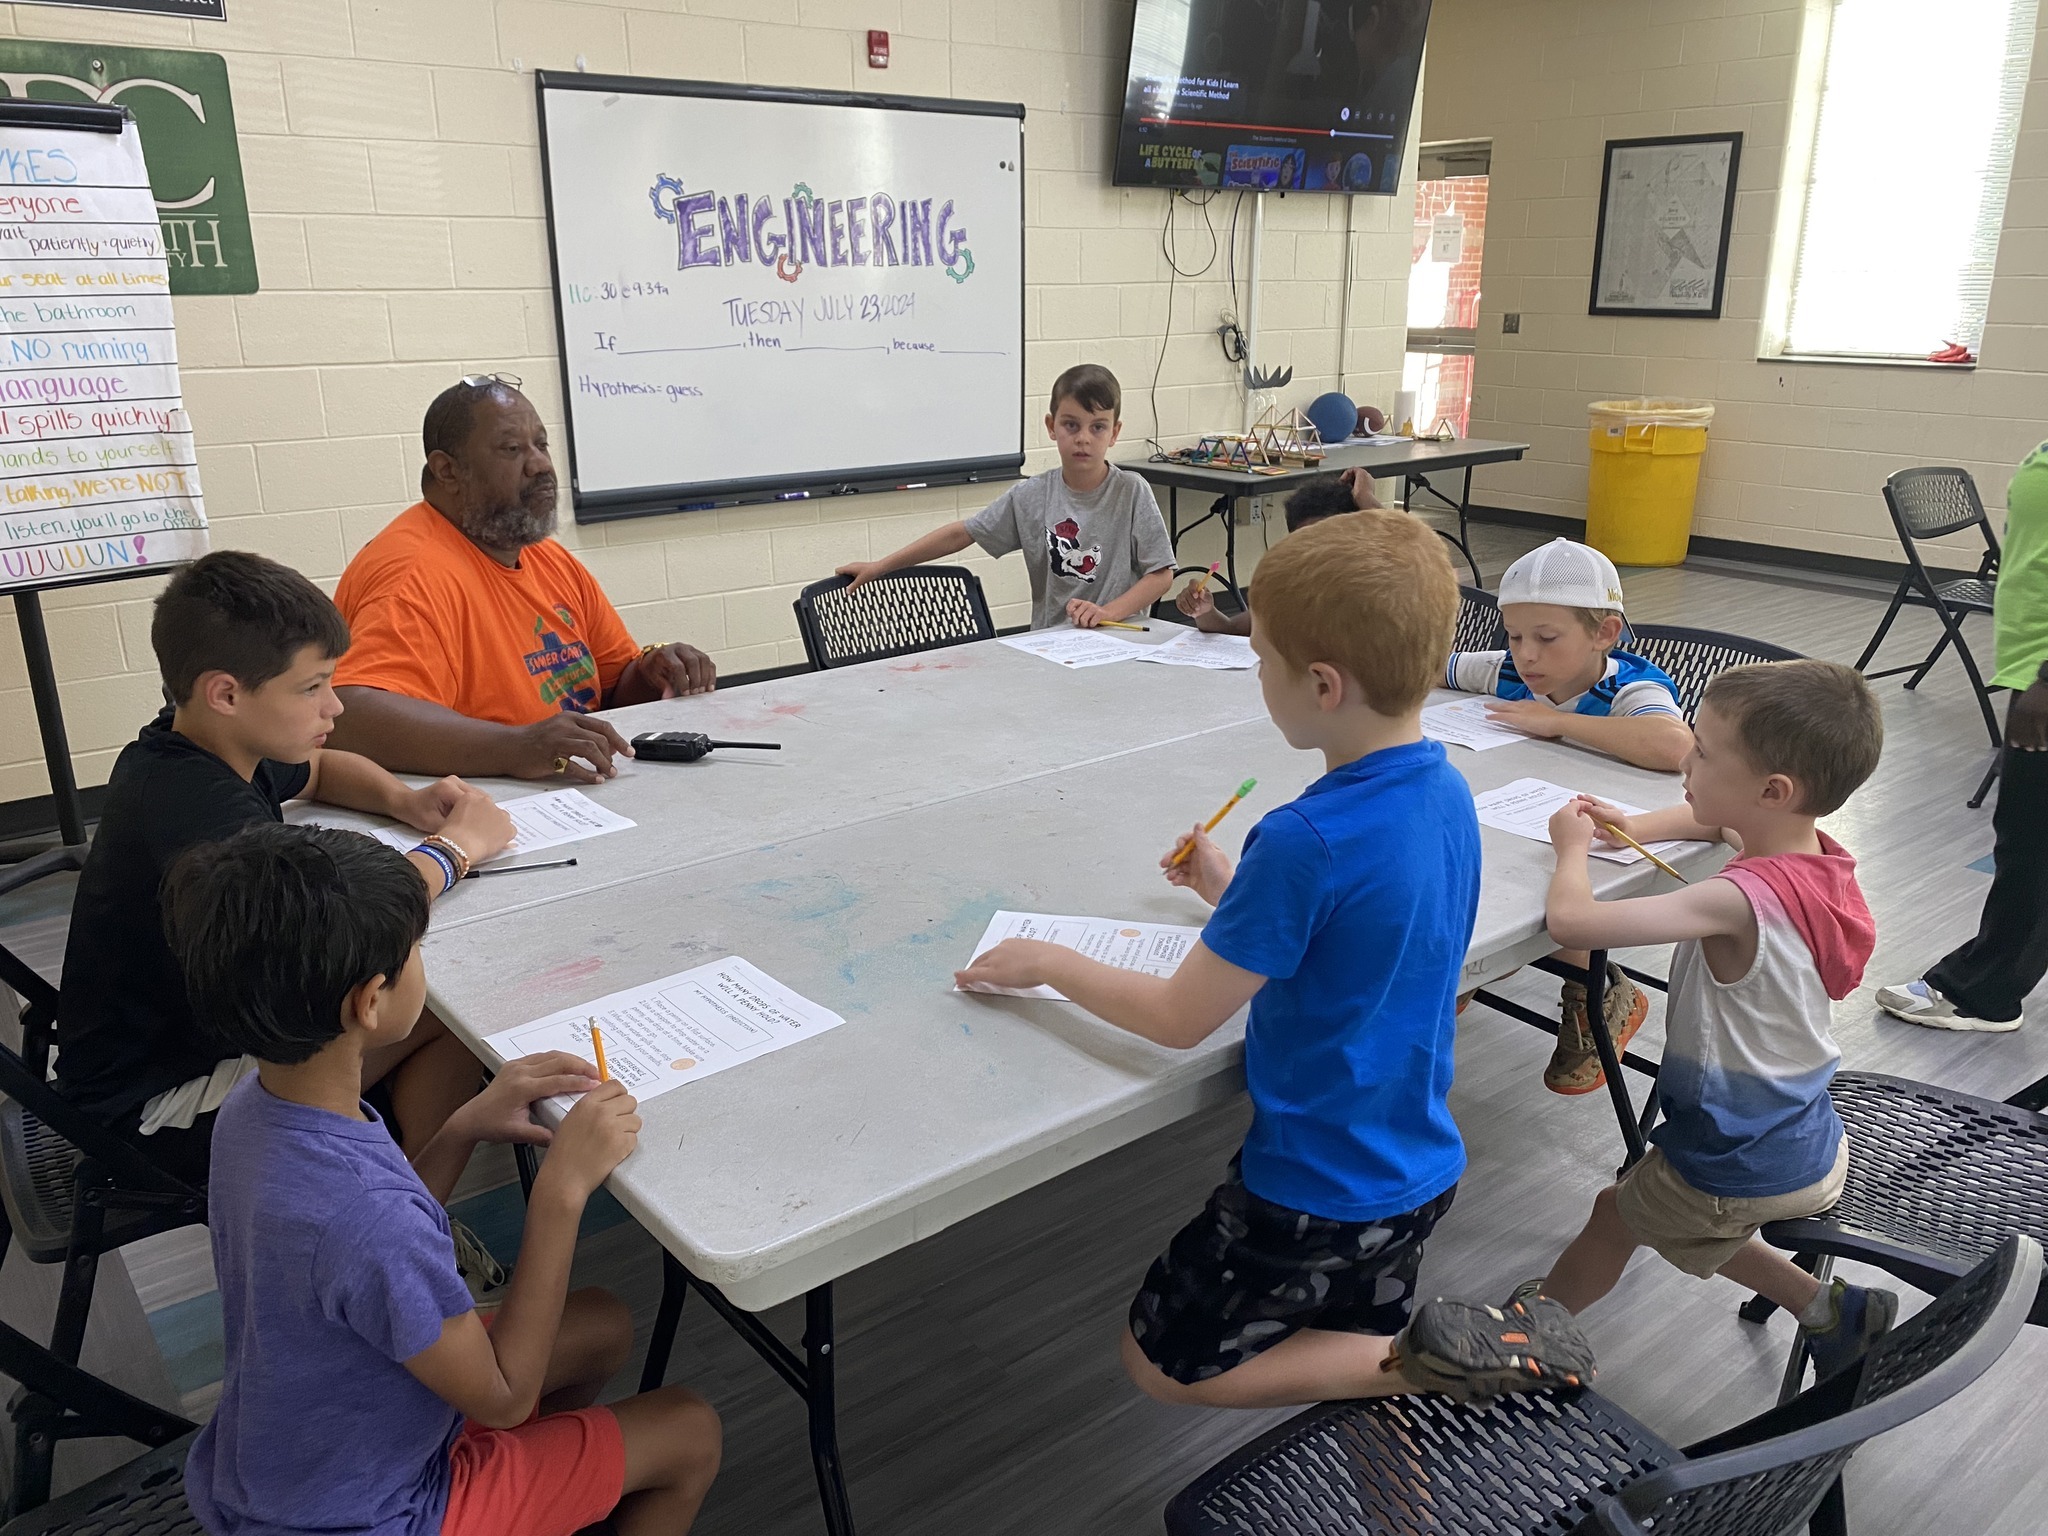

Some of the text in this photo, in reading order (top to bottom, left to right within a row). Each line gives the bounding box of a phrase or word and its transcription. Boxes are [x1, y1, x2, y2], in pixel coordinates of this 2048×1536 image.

[1206, 78, 1219, 88] Kids
[1223, 80, 1239, 89] Learn
[1139, 144, 1160, 156] LIFE
[1162, 145, 1193, 157] CYCLE
[1151, 157, 1205, 170] BUTTERFLY
[1231, 157, 1281, 171] SCIENTIFIC
[0, 226, 28, 241] ait
[29, 236, 99, 256] patiently
[673, 190, 967, 270] ENGINEERING
[22, 272, 67, 287] seat
[76, 273, 95, 287] at
[98, 271, 118, 286] all
[122, 272, 168, 287] times
[600, 282, 617, 300] 30
[33, 302, 137, 323] bathroom
[722, 297, 804, 338] TUESDAY
[813, 295, 854, 322] JULY
[11, 337, 149, 364] NO running
[594, 331, 617, 352] If
[666, 384, 703, 403] guess
[18, 408, 82, 438] spills
[92, 406, 171, 436] quickly
[68, 446, 87, 464] to
[95, 439, 178, 469] yourself
[136, 471, 187, 493] NOT
[70, 511, 117, 539] you'll
[121, 512, 141, 532] go
[144, 510, 159, 524] to
[164, 508, 191, 519] the
[717, 972, 734, 982] HOW
[732, 983, 752, 995] MANY
[749, 996, 770, 1009] DROPS
[779, 1014, 801, 1028] WATER
[718, 983, 733, 994] WILL
[737, 998, 760, 1011] PENNY
[756, 1011, 780, 1024] HOLD?
